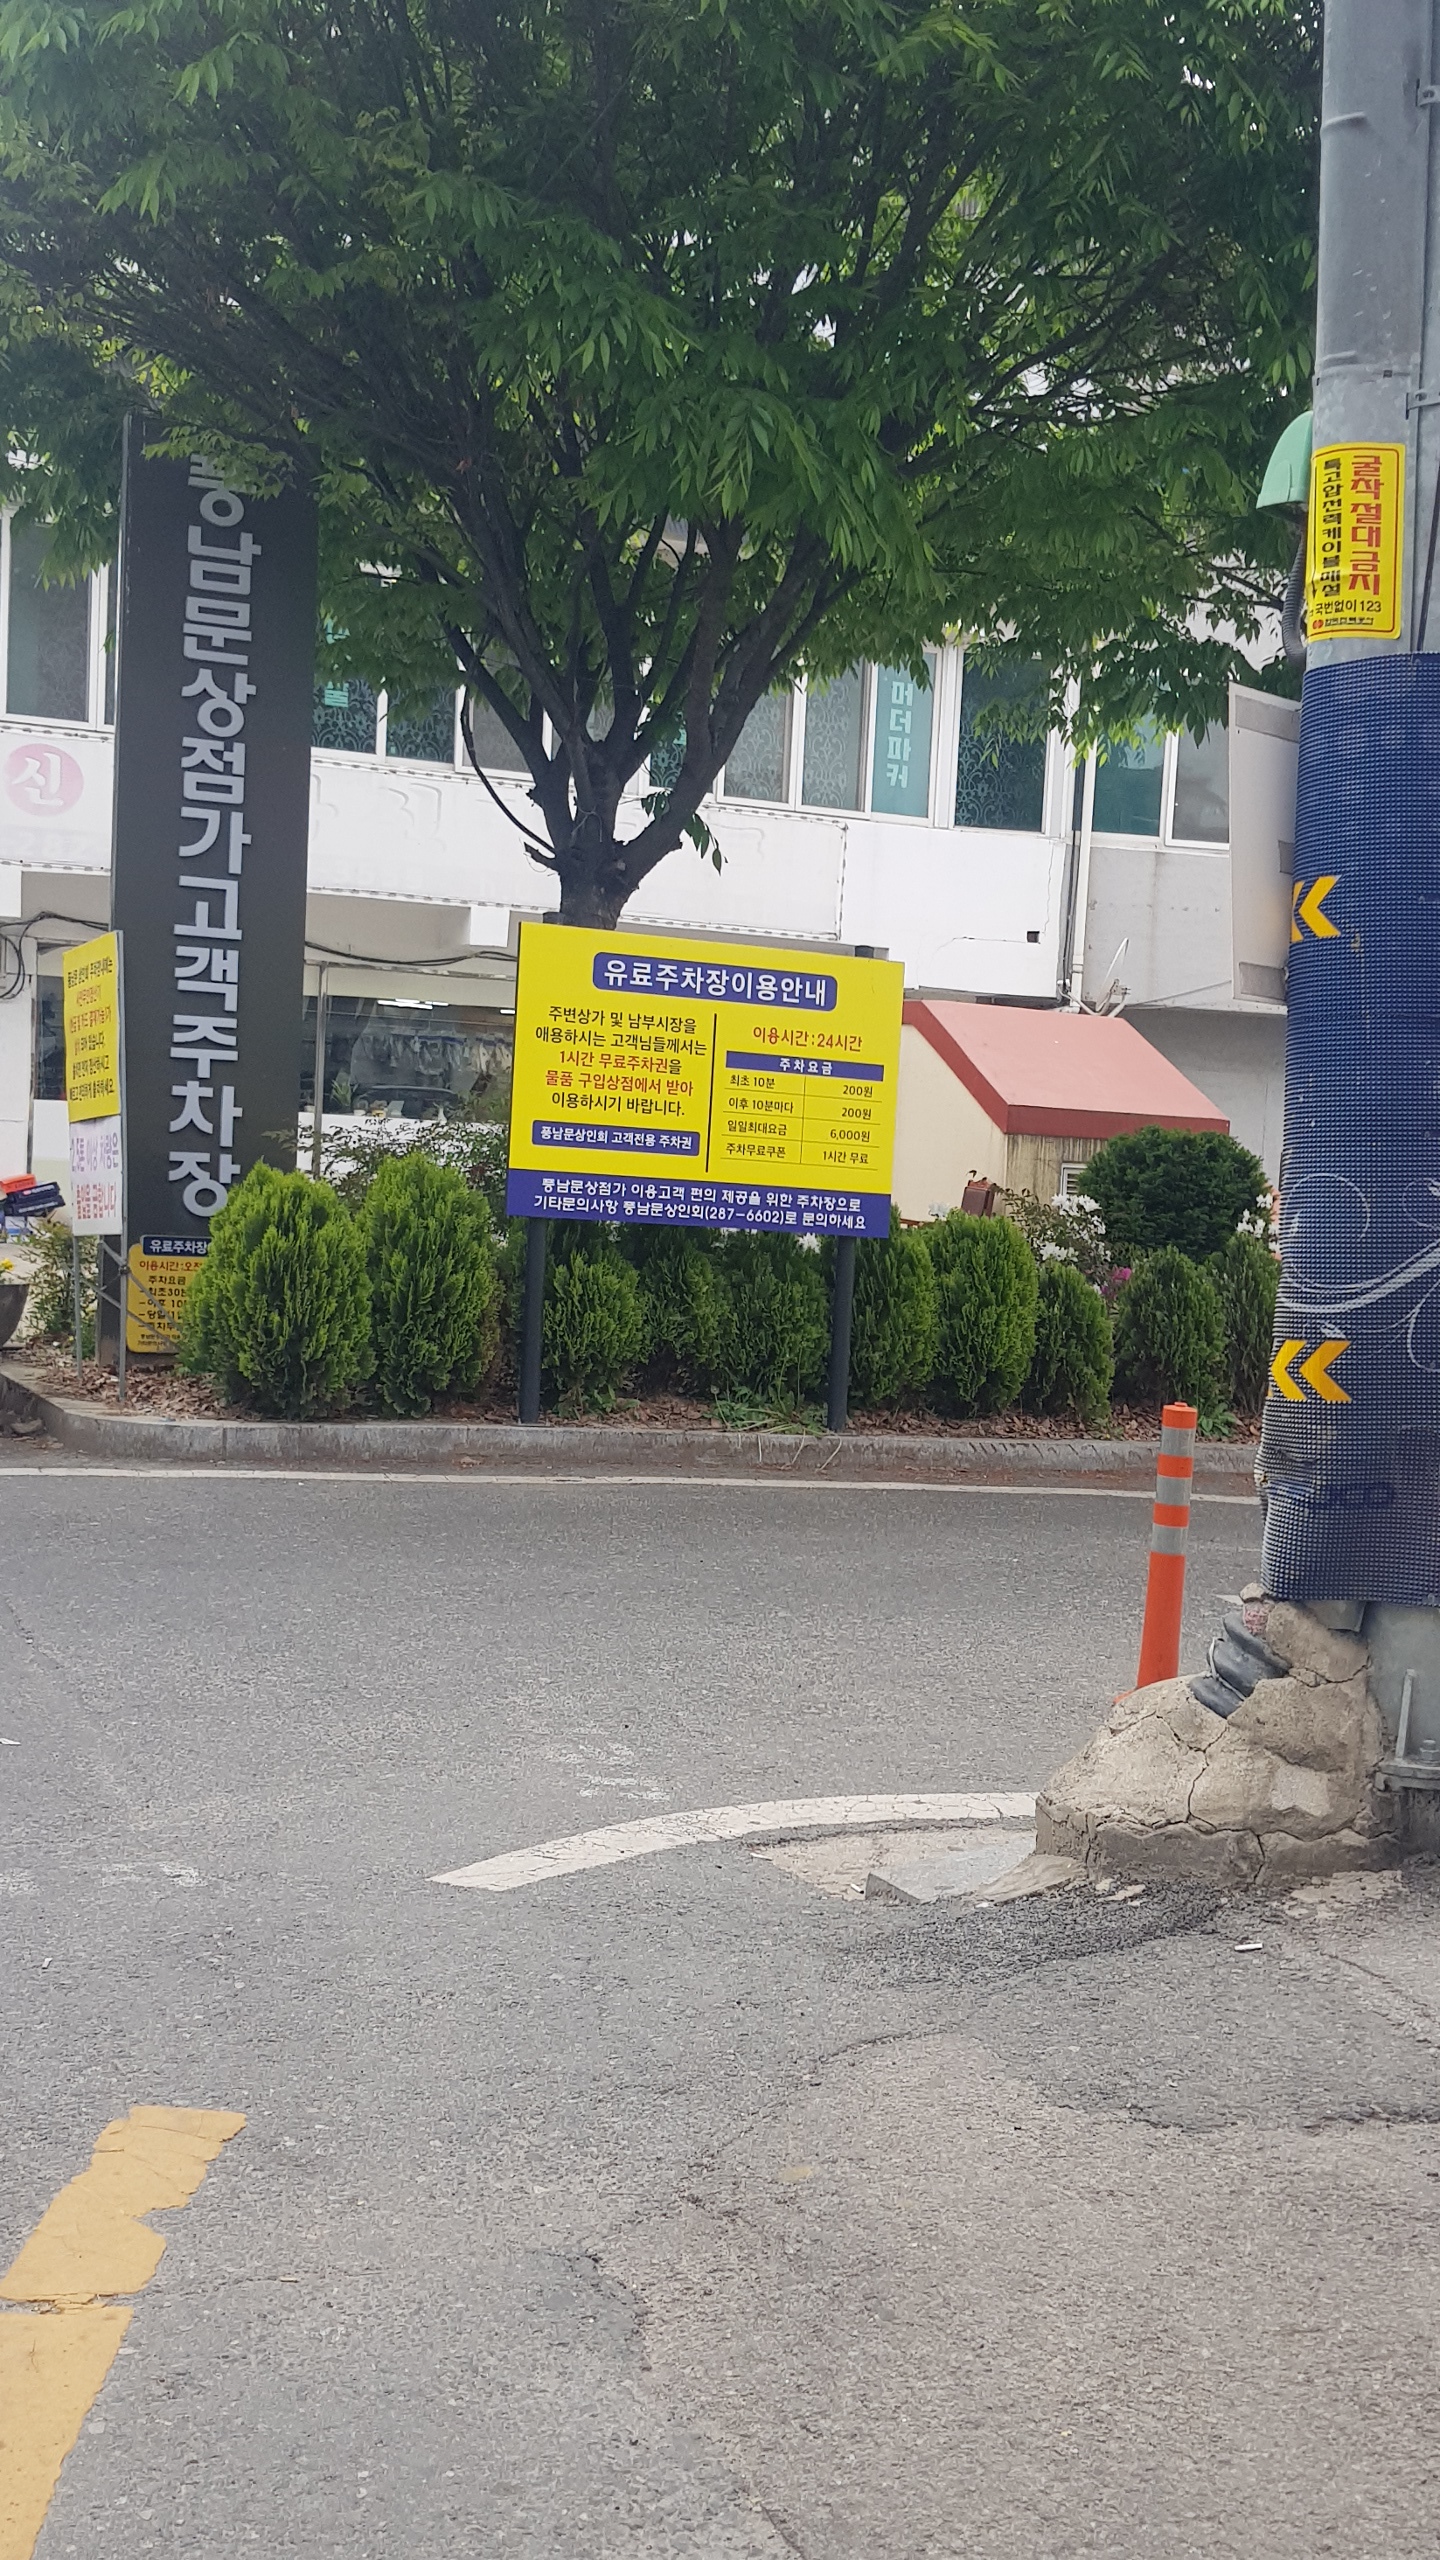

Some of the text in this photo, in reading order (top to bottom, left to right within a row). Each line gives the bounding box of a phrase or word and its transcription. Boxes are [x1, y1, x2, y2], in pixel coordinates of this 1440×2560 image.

[1348, 455, 1384, 596] 굴착 절대 금지
[1360, 600, 1382, 613] 123
[886, 681, 914, 789] 머더마커
[11, 752, 64, 807] 신
[604, 959, 827, 1007] 유료주차장이용안내
[549, 1005, 697, 1035] 주변상가 및 남부시장을
[535, 1026, 708, 1057] 애용하시는 고객님들께서는
[753, 1026, 863, 1053] 이용시간:24시간
[559, 1050, 682, 1075] 1시간 무료주차권을
[779, 1058, 833, 1076] 주차요금
[545, 1069, 694, 1097] 물품 구입상점에서 받아
[729, 1074, 873, 1098] 최초 10분 200원
[552, 1092, 685, 1117] 이용하시기 바랍니다.
[728, 1097, 872, 1121] 이후 10분마다 200원
[540, 1125, 692, 1150] 풍남문상인회 고객전용 주차권
[727, 1119, 871, 1143] 일일최대요금 6,000원
[725, 1142, 869, 1165] 주차무료쿠폰 1시간 무료
[541, 1178, 861, 1213] 풍남문상점가 이용고객 편의 제공을 위한 주차장으로
[533, 1195, 619, 1216] 기타문의사항
[802, 1212, 867, 1230] 문의하세요
[148, 1276, 187, 1285] 주차요금
